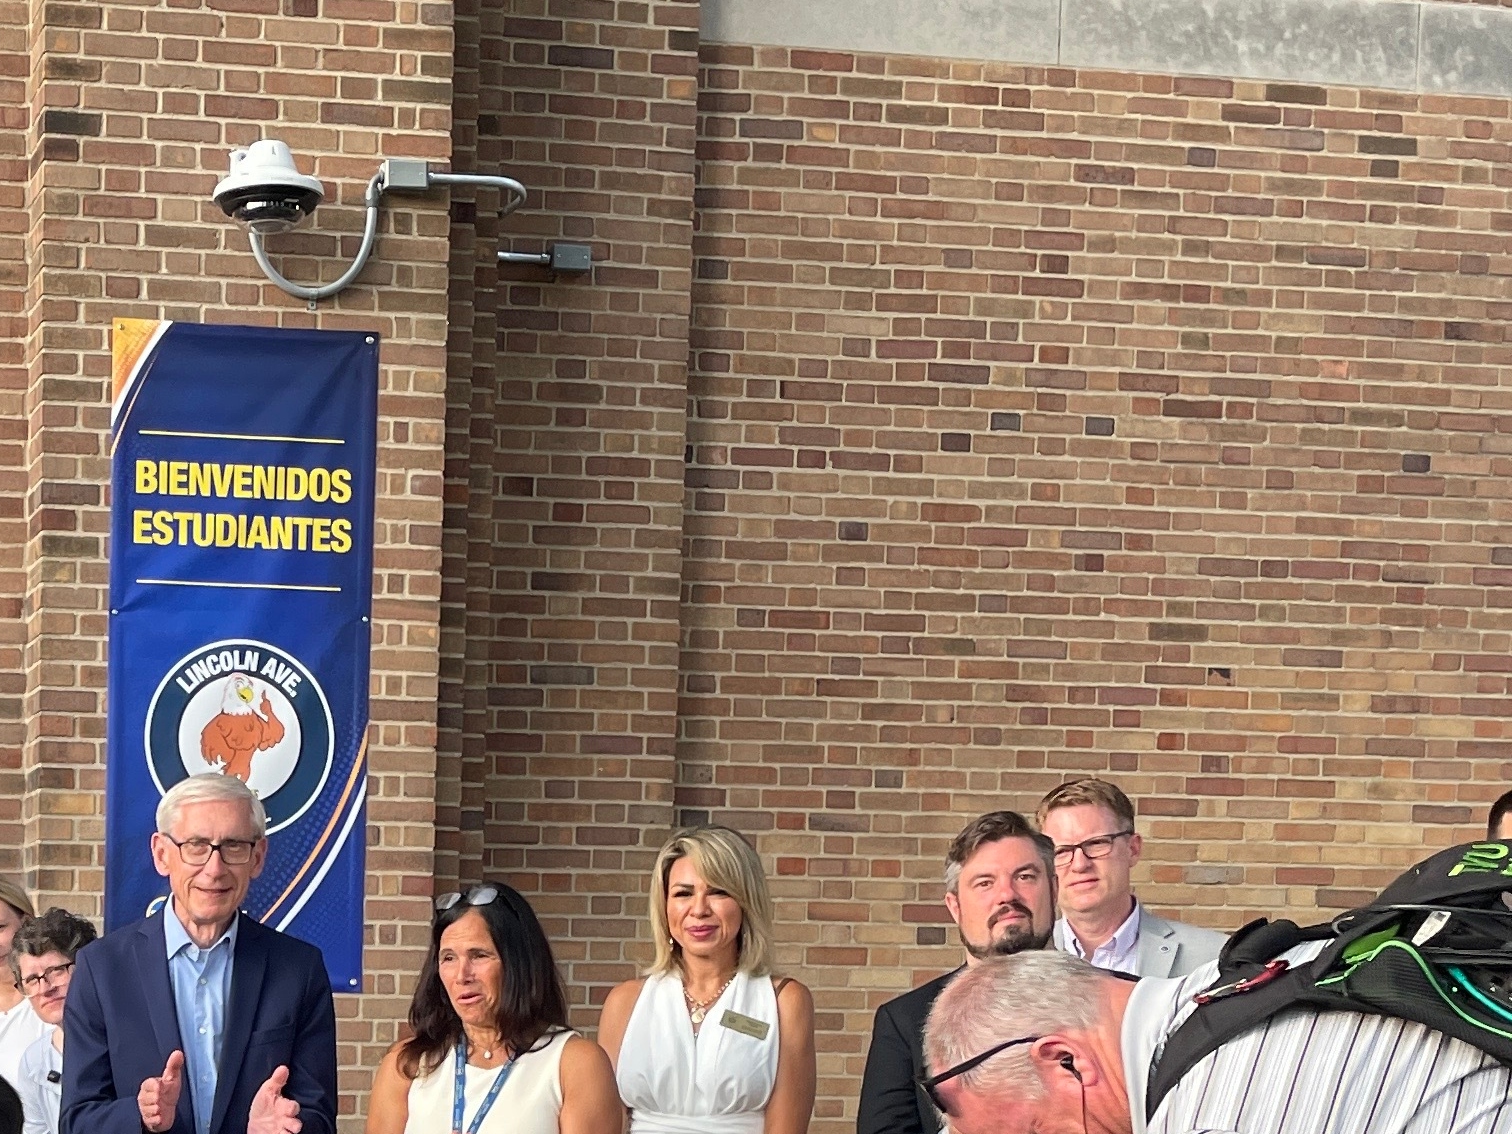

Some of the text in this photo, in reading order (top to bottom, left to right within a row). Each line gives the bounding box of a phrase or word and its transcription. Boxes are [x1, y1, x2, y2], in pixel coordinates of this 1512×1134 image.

[135, 459, 352, 504] BIENVENIDOS
[133, 510, 352, 554] ESTUDIANTES
[175, 649, 302, 698] LINCOLN AVE.
